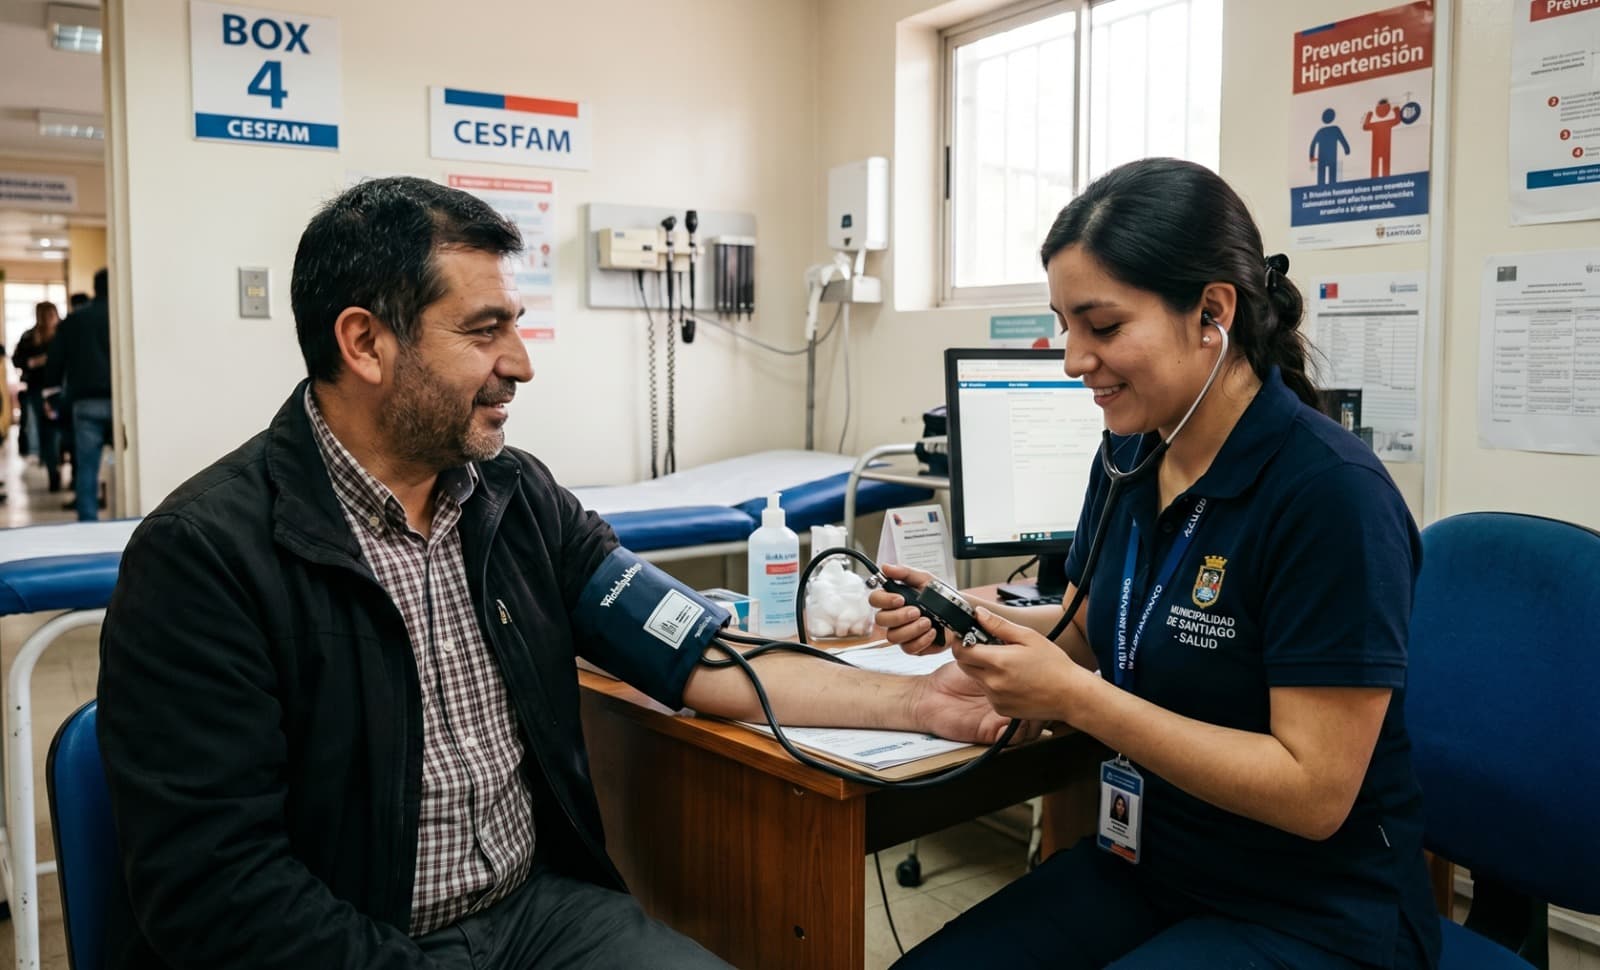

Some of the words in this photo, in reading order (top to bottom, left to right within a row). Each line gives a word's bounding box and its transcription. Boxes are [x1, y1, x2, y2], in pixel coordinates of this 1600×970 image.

[222, 13, 311, 54] BOX
[1302, 26, 1404, 64] Prevención
[1301, 45, 1424, 84] Hipertensión
[247, 60, 288, 109] 4
[227, 119, 310, 142] CESFAM
[453, 120, 571, 153] CESFAM
[1166, 616, 1178, 627] DE
[1178, 618, 1236, 638] SANTIAGO
[1170, 604, 1235, 627] MUNICIPALIDAD
[1179, 632, 1218, 649] SALUD
